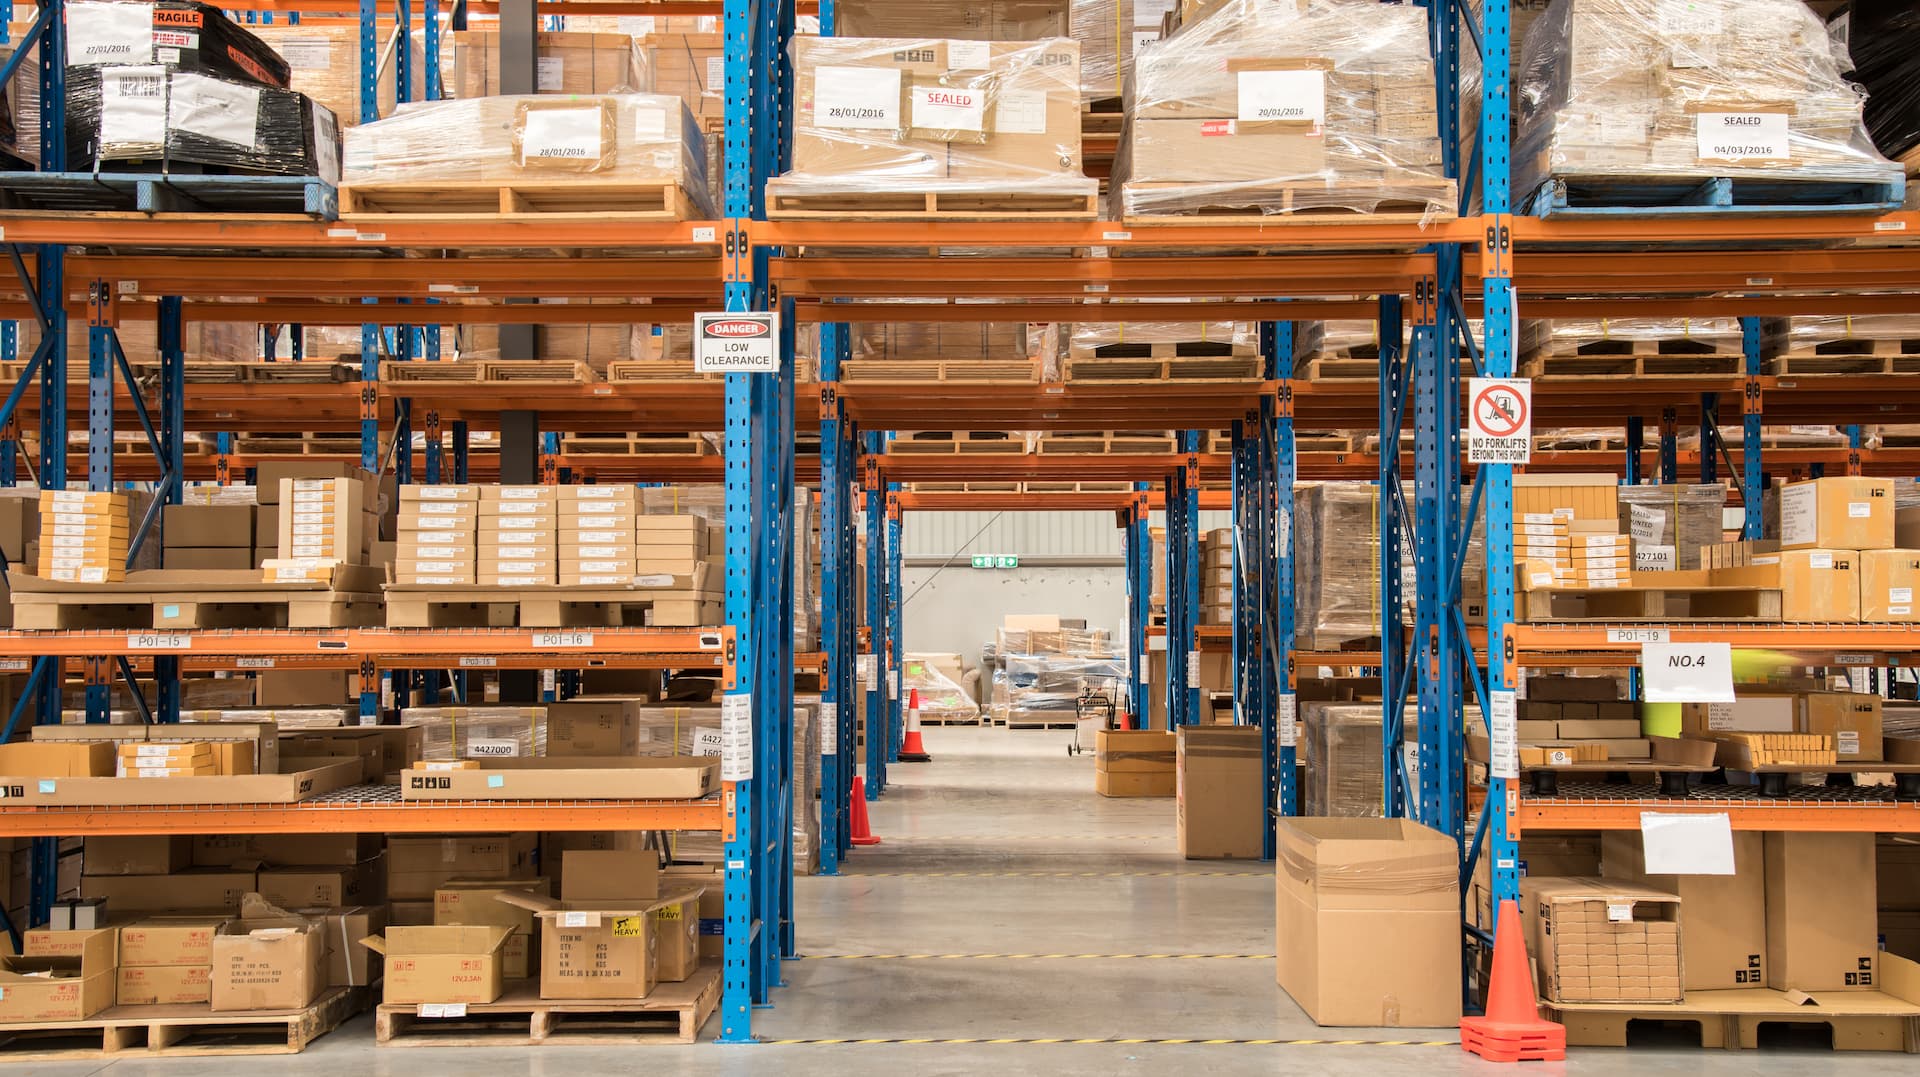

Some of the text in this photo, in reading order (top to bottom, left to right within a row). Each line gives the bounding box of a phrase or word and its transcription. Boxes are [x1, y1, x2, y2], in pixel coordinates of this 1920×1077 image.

[86, 44, 131, 54] 27/01/2016
[927, 92, 972, 106] SEALED
[829, 107, 884, 118] 28/01/2016
[1258, 107, 1304, 117] 20/01/2016
[1724, 116, 1761, 125] SEALED
[539, 147, 586, 157] 28/01/2016
[1714, 145, 1773, 155] 04/03/2016
[713, 324, 759, 334] DANGER
[724, 343, 749, 352] LOW
[704, 355, 770, 365] CLEARANCE
[1472, 438, 1527, 449] NO FORKLIFTS
[1472, 449, 1526, 461] BEYOND THIS POINT
[543, 634, 583, 645] P01-16
[1618, 631, 1659, 641] P01-19
[138, 636, 180, 647] P01-15
[1668, 655, 1705, 668] NO.4
[474, 744, 512, 754] 4427000
[614, 928, 640, 936] HEAVY
[596, 943, 608, 951] PCS
